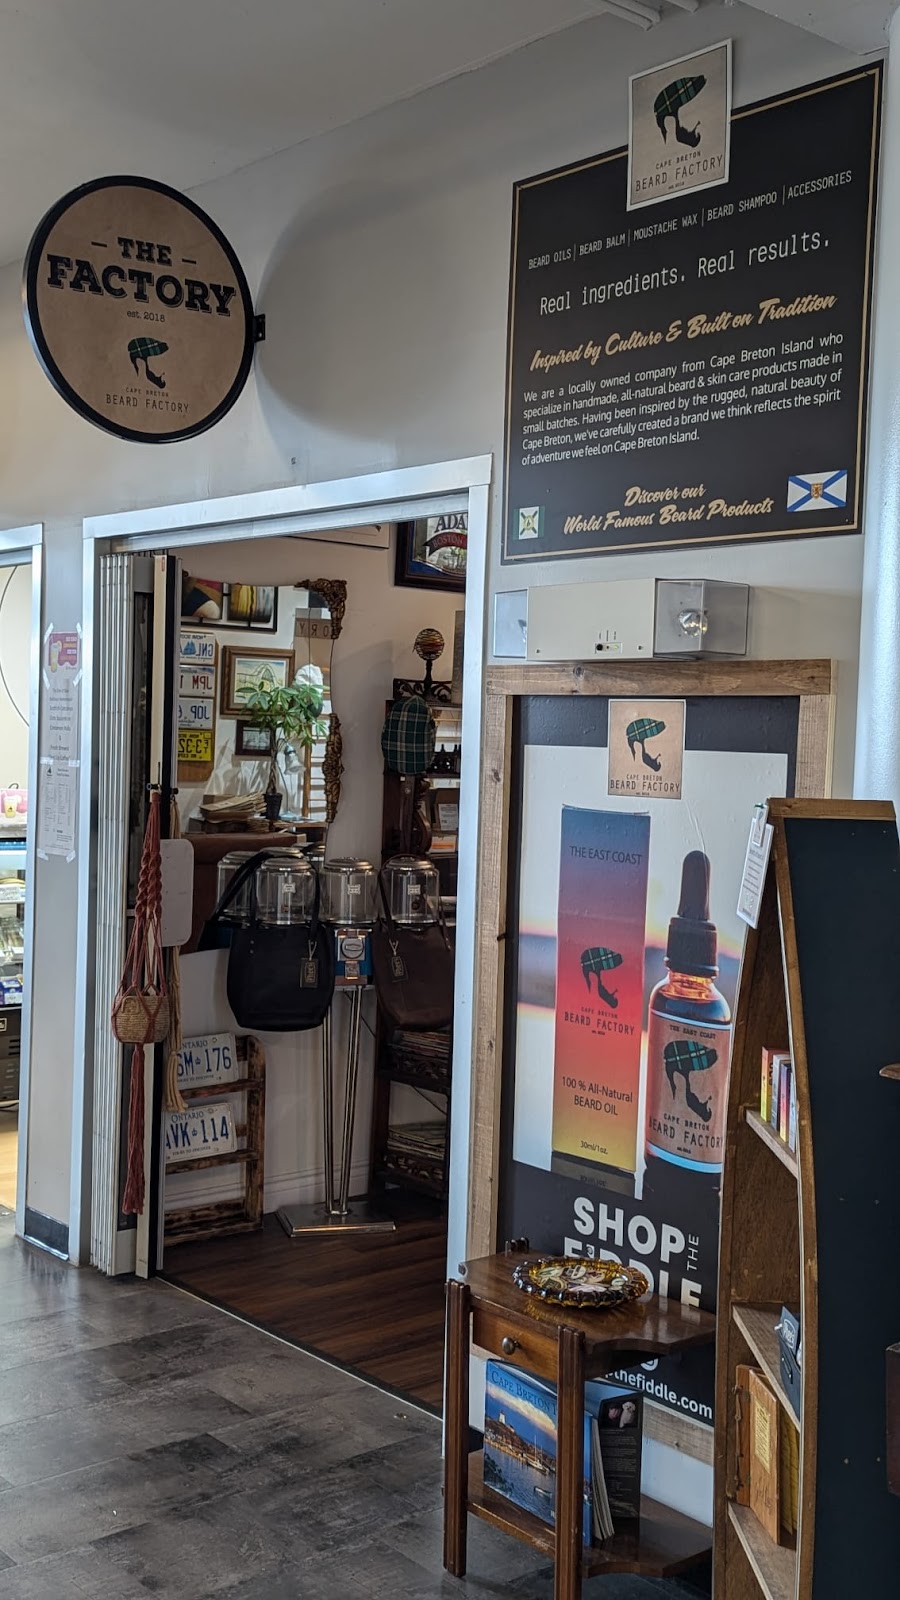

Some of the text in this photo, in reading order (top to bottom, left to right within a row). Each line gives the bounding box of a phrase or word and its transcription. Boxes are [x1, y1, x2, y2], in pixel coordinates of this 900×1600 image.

[635, 154, 723, 192] BEARD FACTORY
[655, 150, 701, 170] CAPE BRETON
[528, 170, 852, 270] BEARD OILS BEARD BALM MOUSTACHE WAX BEARD SHAMPOO ACCESSORIES
[118, 237, 172, 266] THE
[47, 254, 236, 316] FACTORY
[540, 232, 828, 315] Real ingredients. Real results.
[127, 310, 166, 322] est. 2018
[530, 294, 838, 373] Inspired by Culture & Built on Tradition
[523, 332, 843, 403] We are a locally owned company from Cape Breton Island who
[523, 350, 842, 421] specialize in handmade, all-natural beard & skin care products made in
[106, 394, 189, 412] BEARD FACTORY
[522, 368, 842, 435] small batches. Having been inspired by the rugged, natural beauty of
[522, 388, 841, 451] Cape Breton, we've carefully created a brand we think reflects the spirit
[521, 428, 700, 466] of adventure we feel on Cape Breton Island.
[624, 483, 706, 507] Discover our
[563, 497, 774, 534] World Famous Beard Products
[432, 534, 463, 548] BOSTON
[610, 780, 680, 792] BEARD FACTORY
[569, 846, 642, 864] THE EAST COAST
[564, 1012, 635, 1035] BEARD FACTORY
[598, 1010, 618, 1019] BRETON
[180, 1040, 208, 1050] NTARIO
[683, 1027, 697, 1036] EAST
[205, 1046, 231, 1072] 176
[562, 1076, 576, 1088] 100
[588, 1083, 633, 1103] All-Natural
[172, 1111, 204, 1123] ONTARIO
[574, 1095, 618, 1115] BEARD OIL
[201, 1116, 228, 1143] 114
[664, 1113, 709, 1131] CAPE BRETON
[574, 1197, 686, 1263] SHOP
[687, 1234, 699, 1270] THE
[492, 1370, 514, 1392] CAPE
[516, 1383, 550, 1412] BRETON
[605, 1369, 713, 1419] thefiddle.com
